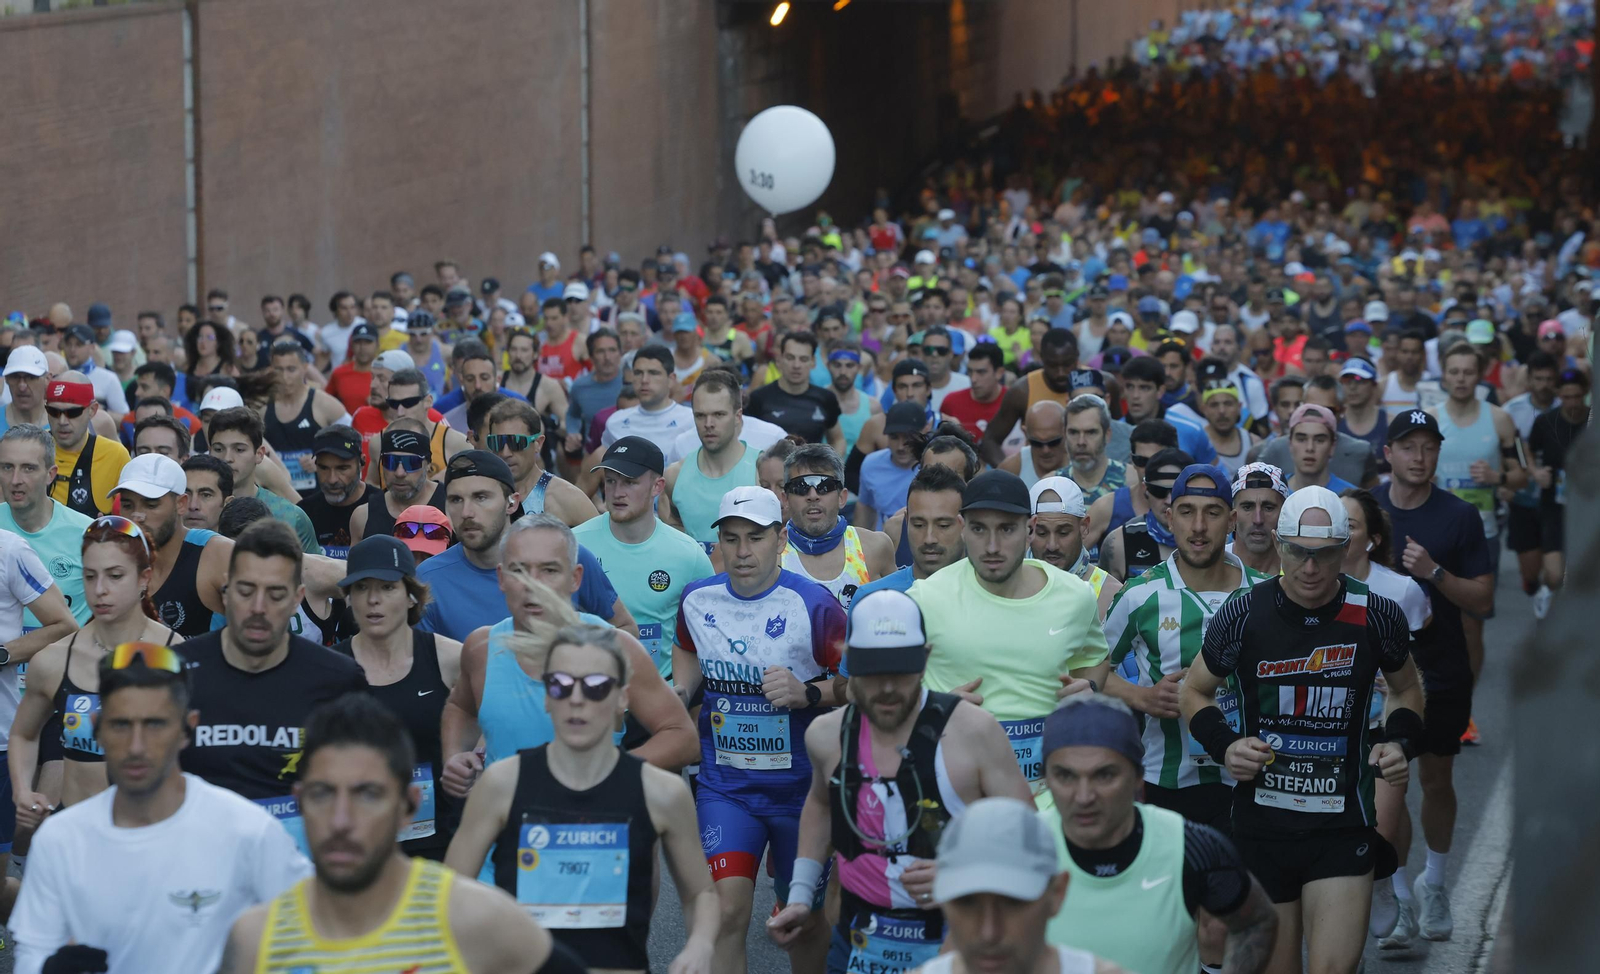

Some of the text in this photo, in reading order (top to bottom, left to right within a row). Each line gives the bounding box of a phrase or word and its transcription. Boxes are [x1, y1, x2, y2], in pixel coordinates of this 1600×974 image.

[750, 168, 774, 190] 3:30
[329, 549, 349, 557] ZURI
[1258, 659, 1307, 676] SPRINT
[1304, 648, 1325, 672] 4
[707, 679, 763, 695] ANNIVERS
[735, 702, 778, 712] ZURICH
[1345, 687, 1356, 719] SPORT
[737, 723, 759, 733] 7201
[196, 724, 300, 748] REDOLAT
[717, 735, 785, 751] MASSIMO
[1288, 740, 1337, 751] ZURICH
[1289, 761, 1313, 773] 4175
[1265, 773, 1337, 793] STEFANO
[556, 830, 617, 845] ZURICH
[558, 862, 590, 875] 7907
[883, 925, 926, 939] ZURIC
[882, 949, 912, 962] 6615
[849, 955, 906, 974] ALEXA
